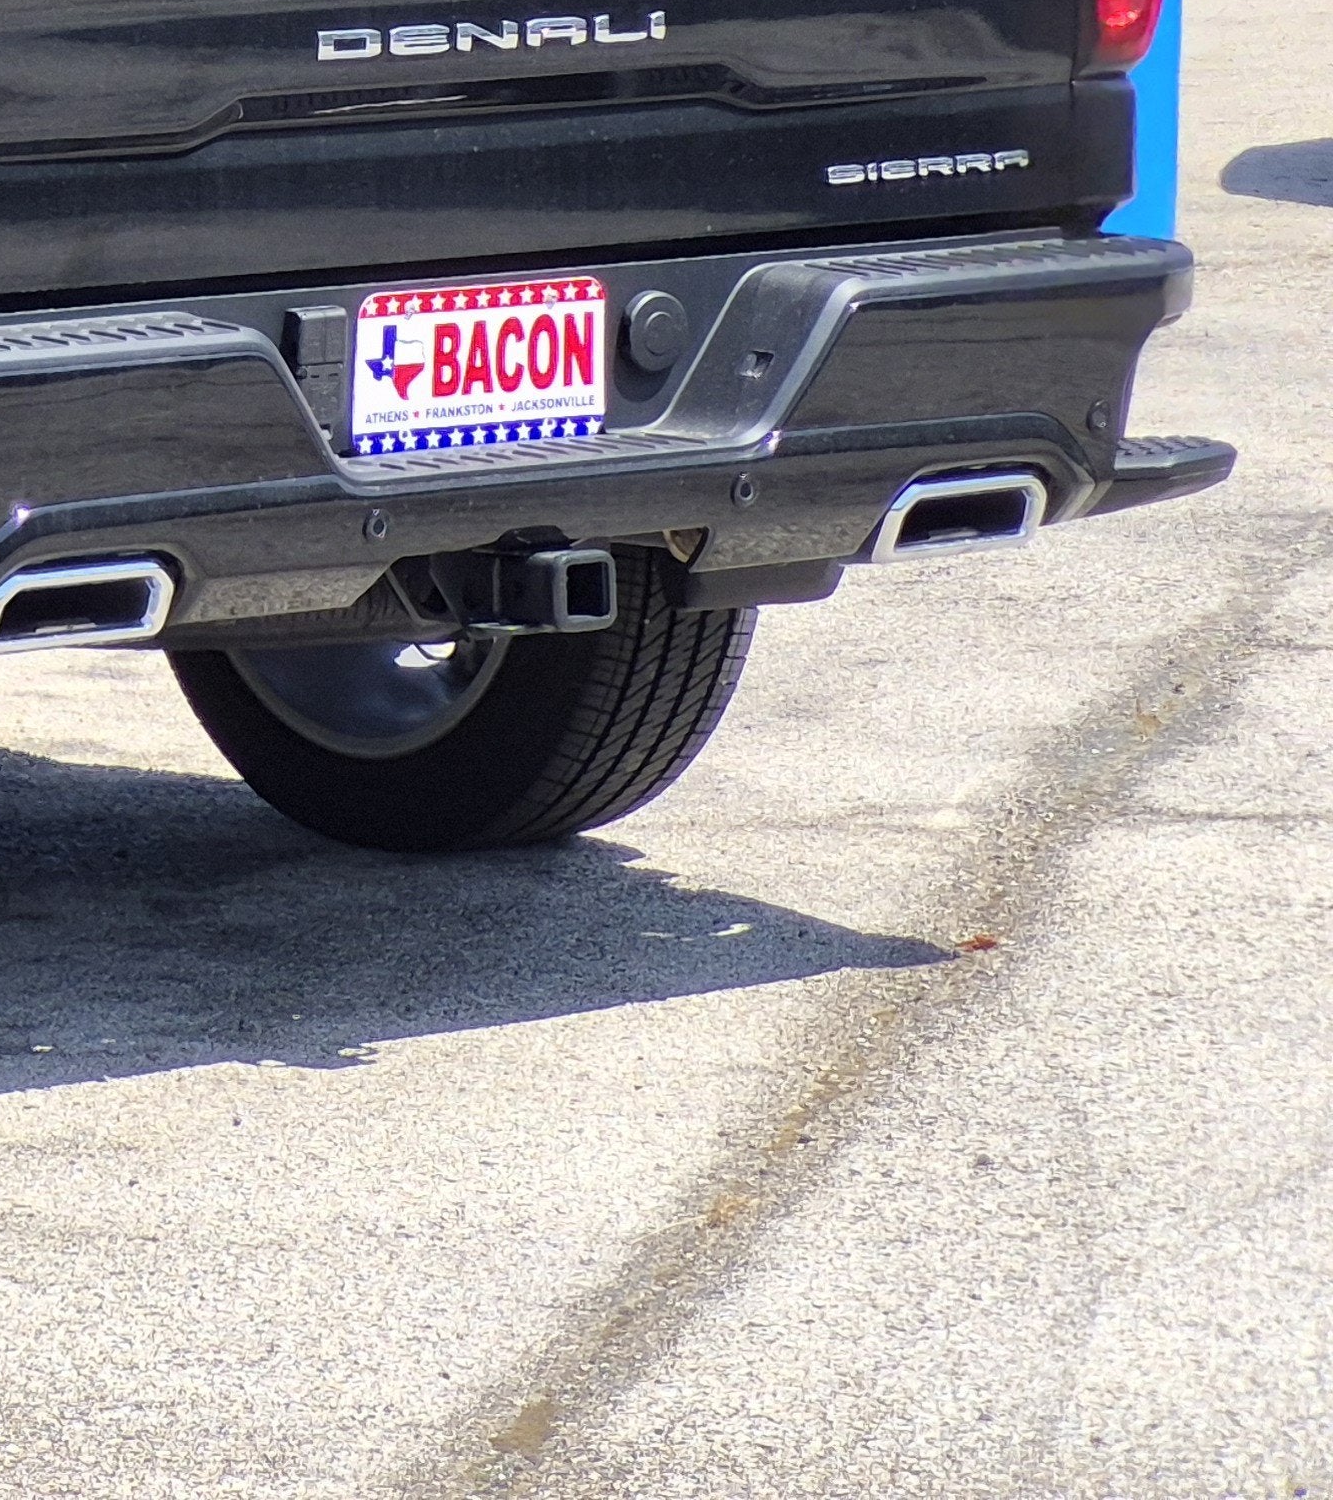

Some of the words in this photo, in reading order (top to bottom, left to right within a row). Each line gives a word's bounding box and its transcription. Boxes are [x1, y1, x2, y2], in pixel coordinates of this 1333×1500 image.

[316, 10, 668, 61] DENALI
[827, 149, 1030, 185] SIERRA
[431, 311, 595, 398] BACON
[364, 409, 409, 424] ATHENS
[425, 402, 494, 420] FRANKSTON
[511, 395, 595, 412] JACKSONVILLE
